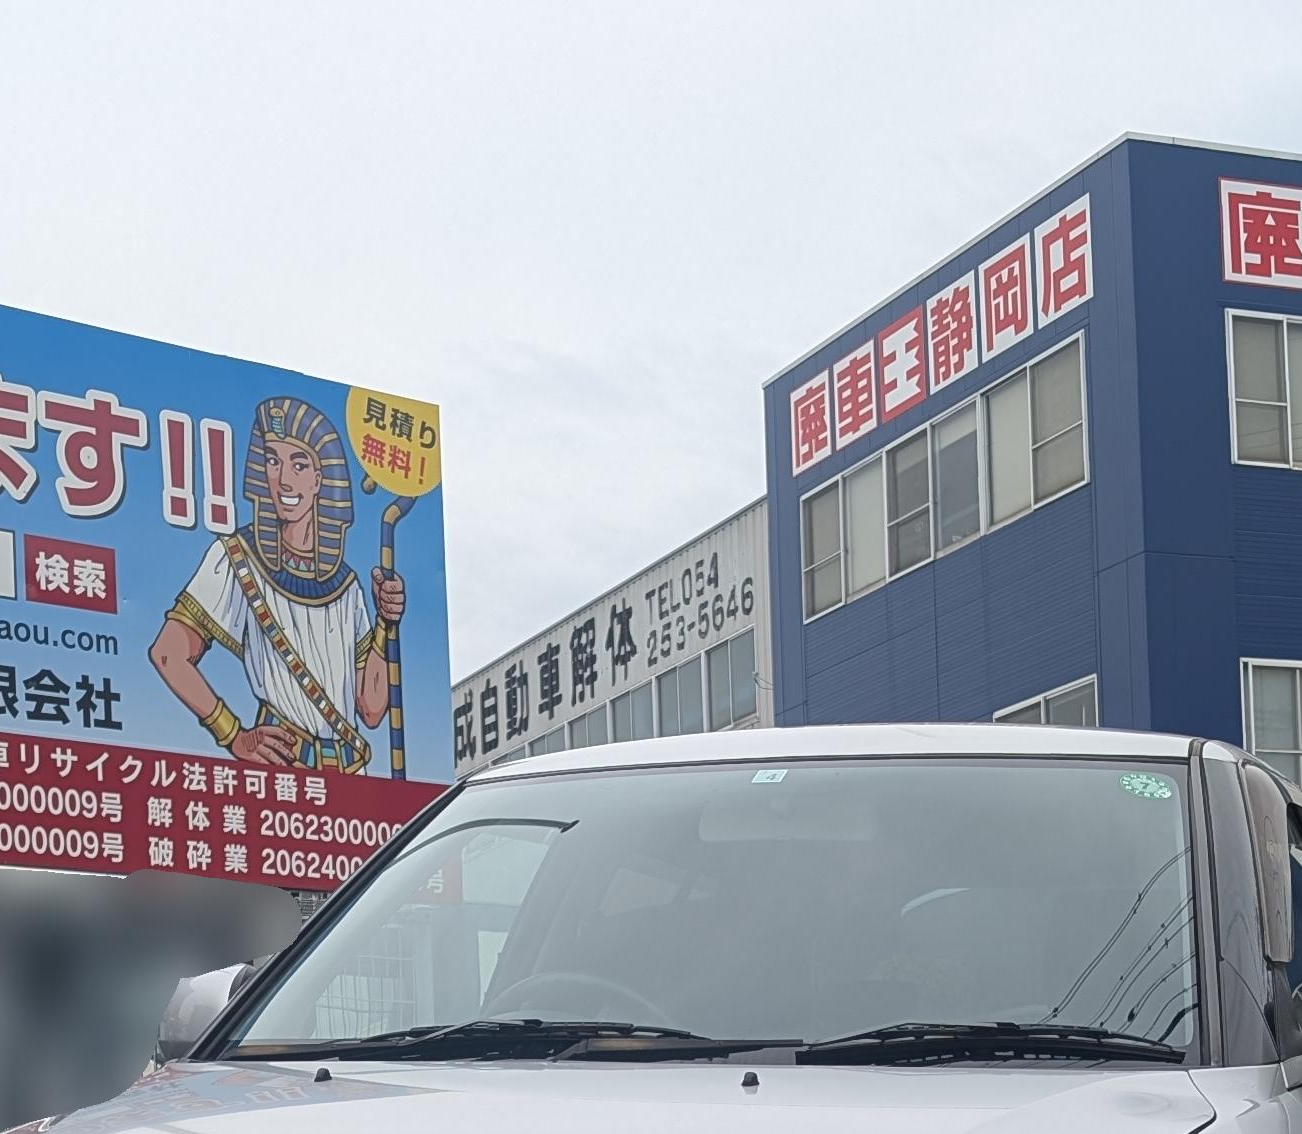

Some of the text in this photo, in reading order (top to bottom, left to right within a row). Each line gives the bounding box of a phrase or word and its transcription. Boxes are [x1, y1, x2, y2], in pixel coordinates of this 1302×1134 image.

[363, 397, 436, 449] 見積り
[35, 551, 107, 600] 検索
[646, 576, 755, 667] 253-5646
[147, 796, 247, 836] 解体業
[148, 837, 248, 875] 破砕業
